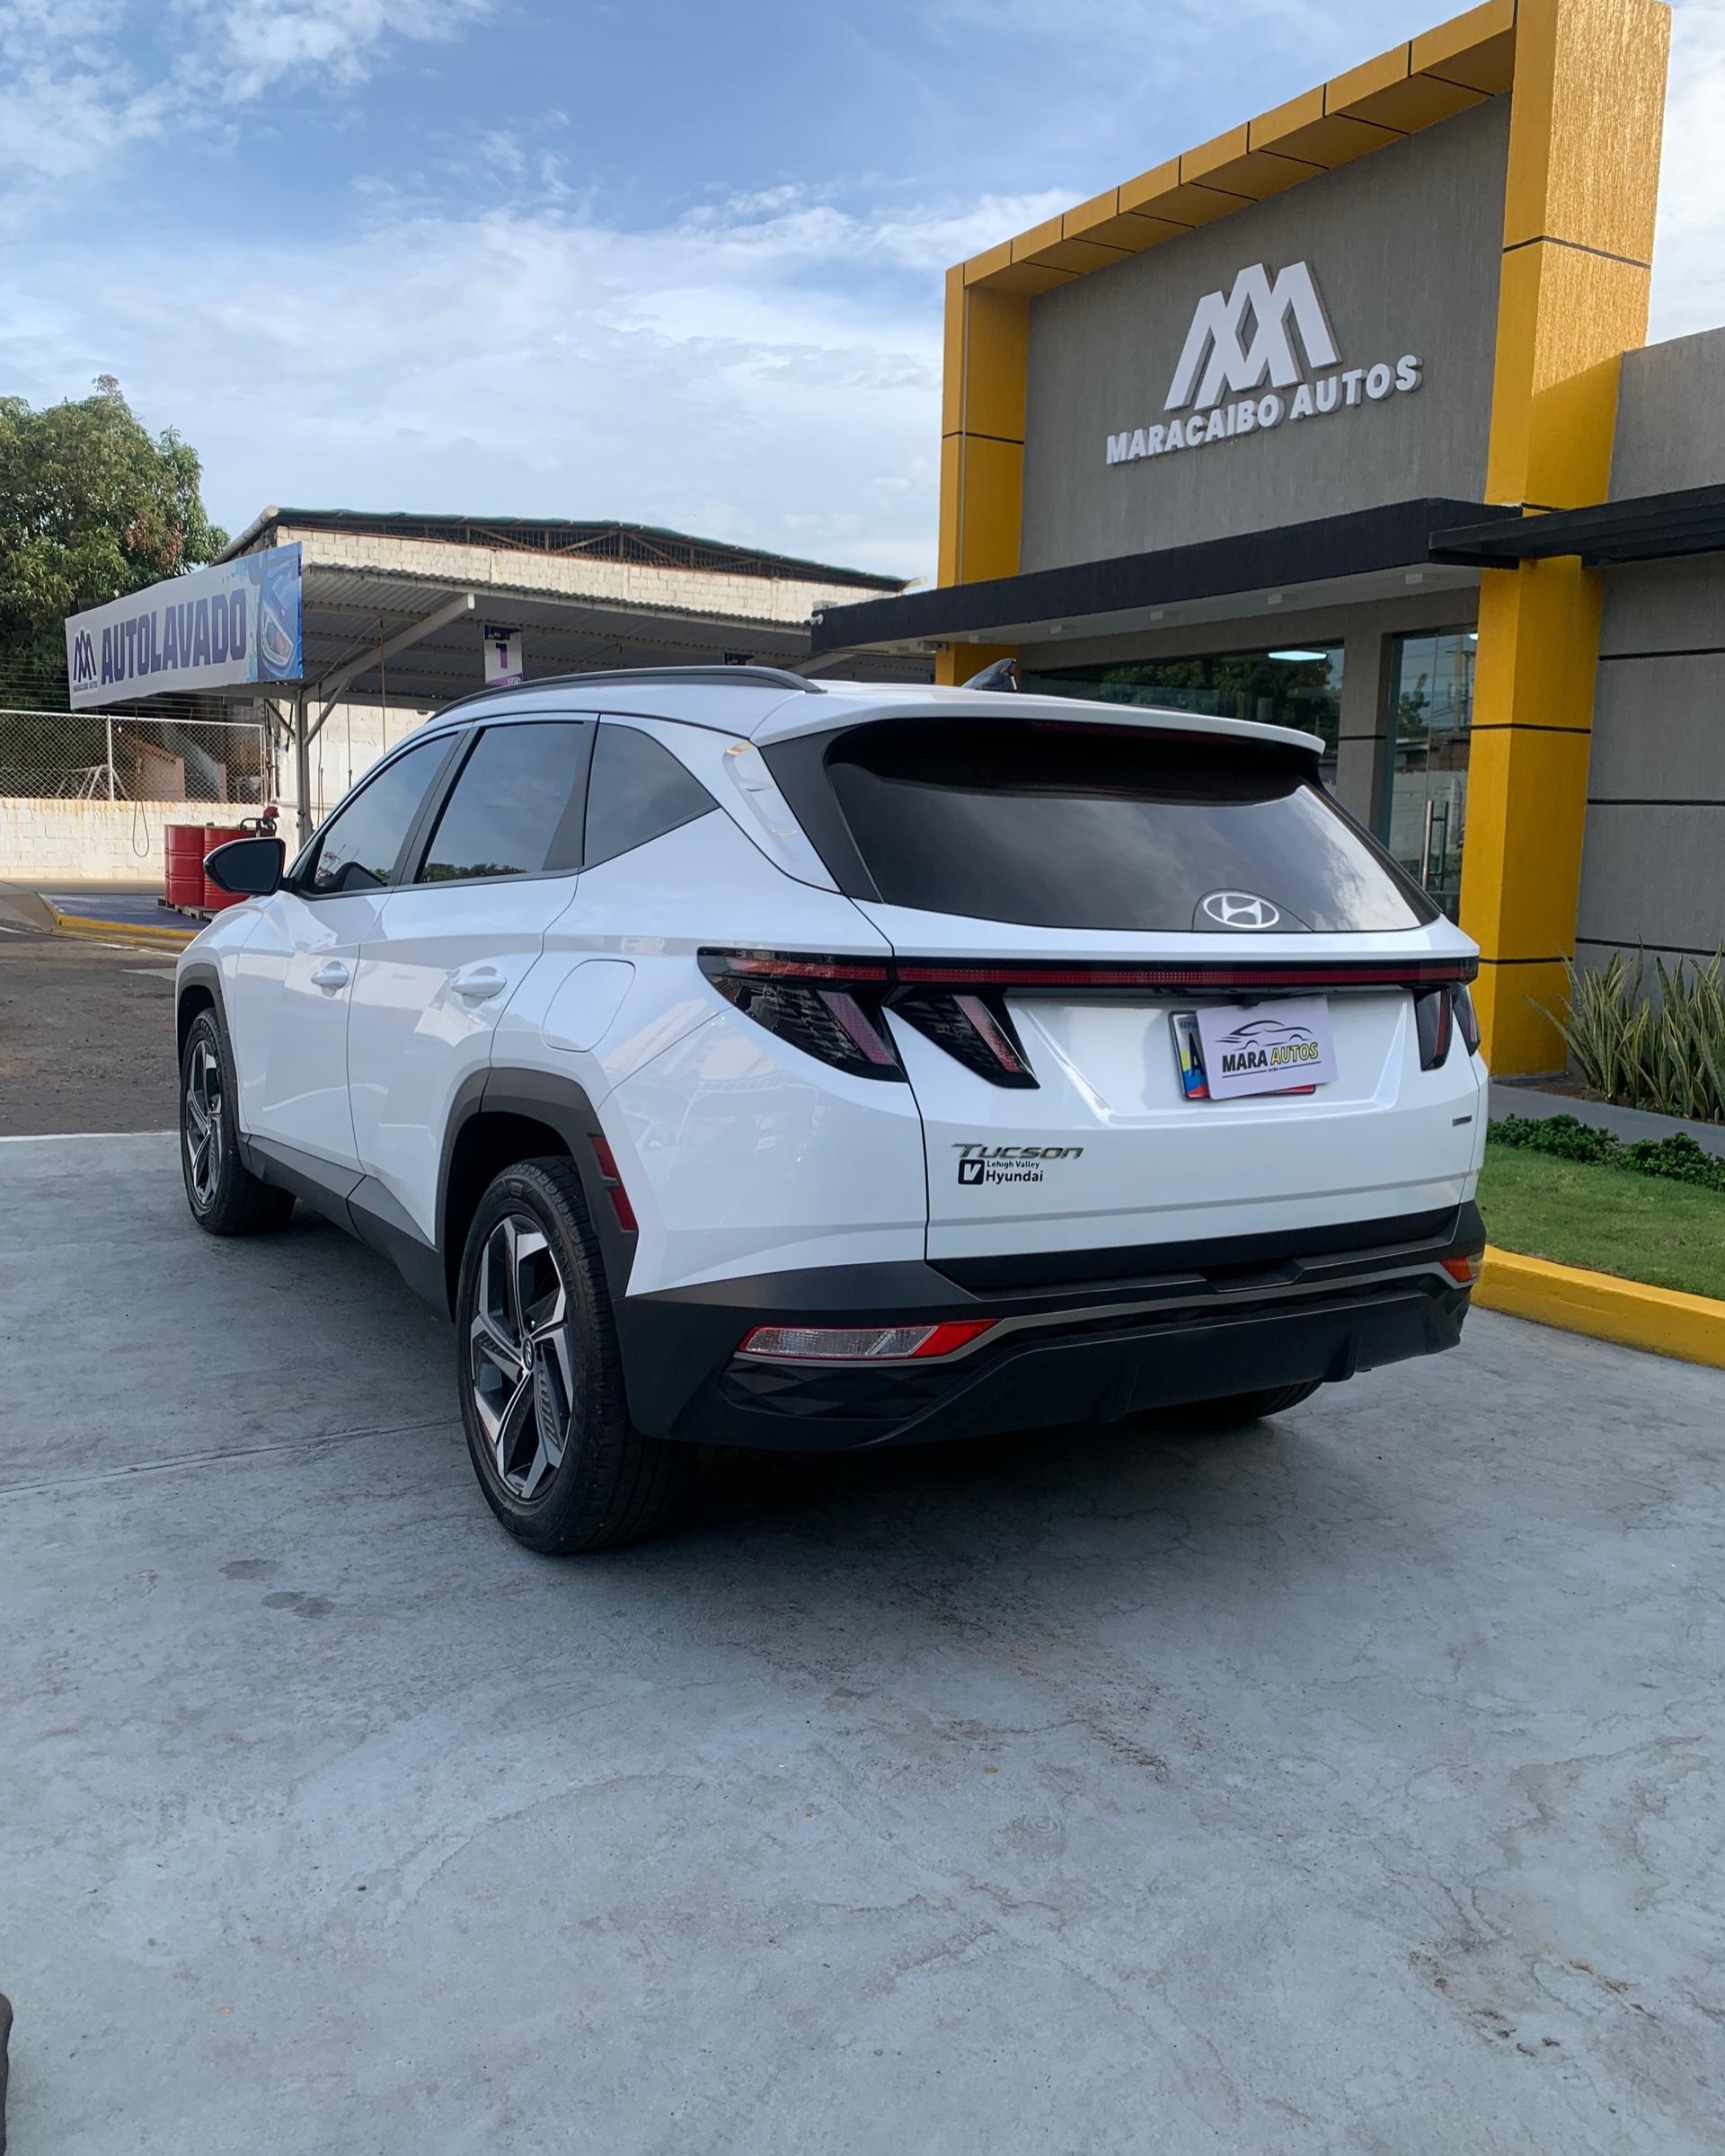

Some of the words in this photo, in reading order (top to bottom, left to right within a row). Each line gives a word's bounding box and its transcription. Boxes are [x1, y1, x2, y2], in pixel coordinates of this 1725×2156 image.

[1106, 393, 1284, 465] MARACAIBO
[1289, 353, 1423, 420] AUTOS
[101, 588, 247, 685] AUTOLAVADO
[495, 642, 509, 669] 1
[1222, 1049, 1268, 1073] MARA
[1269, 1041, 1319, 1066] AUTOS
[986, 1160, 1013, 1169] Lehigh
[1015, 1160, 1040, 1169] Valley
[986, 1170, 1044, 1185] Hyundai
